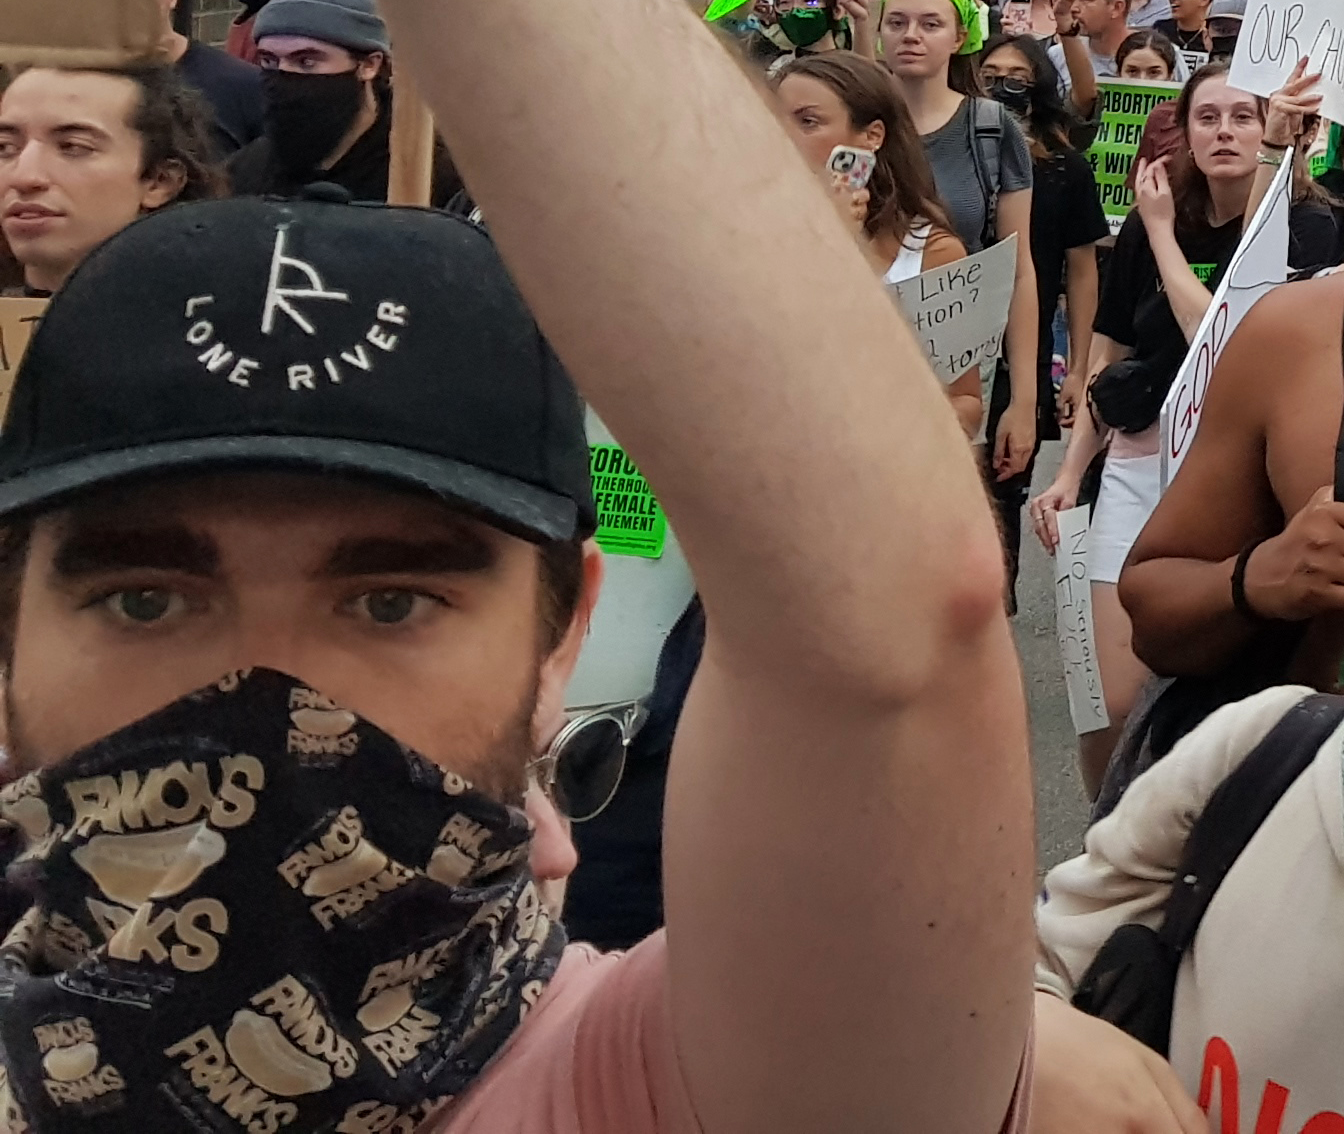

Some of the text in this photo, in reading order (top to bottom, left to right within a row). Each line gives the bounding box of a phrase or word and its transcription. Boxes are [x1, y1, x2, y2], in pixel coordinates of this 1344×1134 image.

[1249, 4, 1303, 68] OUR
[184, 294, 410, 391] LONE RIVER
[596, 492, 657, 516] FEMALE
[598, 513, 656, 532] AVEMENT
